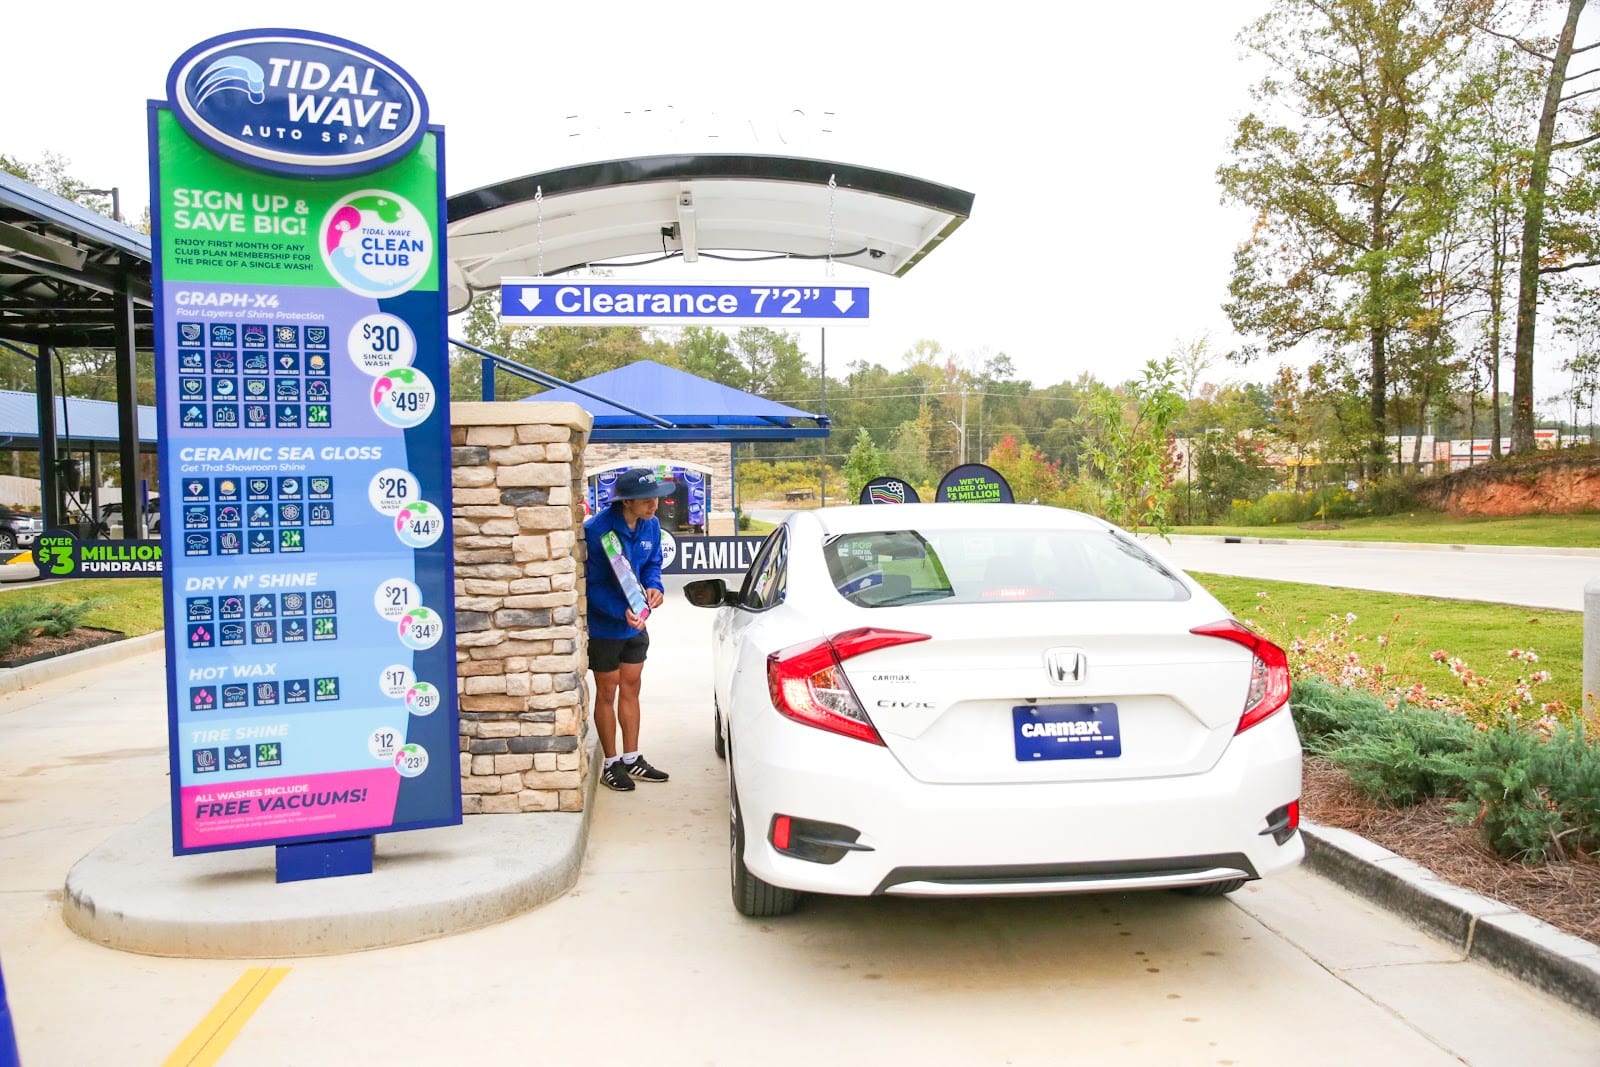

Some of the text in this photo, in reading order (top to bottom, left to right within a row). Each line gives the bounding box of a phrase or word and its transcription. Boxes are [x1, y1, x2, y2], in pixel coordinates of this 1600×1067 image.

[269, 58, 379, 96] TIDAL
[288, 93, 402, 130] WAVE
[242, 125, 365, 145] AUTO SPA
[174, 188, 310, 214] SIGN UP &
[174, 210, 307, 235] SAVE BIG!
[174, 238, 206, 246] ENJOY
[208, 240, 234, 248] FIRST
[236, 241, 268, 250] MONTH
[361, 237, 424, 252] CLEAN
[202, 249, 228, 257] PLAN
[230, 251, 290, 260] MEMBERSHIP
[362, 252, 410, 266] CLUB
[250, 261, 281, 269] SINGLE
[284, 262, 314, 270] WASH!
[175, 291, 280, 308] GRAPH-X4
[554, 287, 738, 313] Clearance
[176, 308, 324, 320] Four Layers of Shine Protection
[363, 323, 400, 352] $30
[180, 446, 382, 462] CERAMIC SEA GLOSS
[181, 463, 306, 472] Get That Showroom Shine
[379, 477, 407, 498] $26
[959, 490, 1000, 499] MILLION
[40, 538, 72, 546] OVER
[38, 546, 75, 575] $3
[681, 541, 762, 570] FAMILY
[185, 576, 230, 591] DRY
[258, 572, 318, 588] SHINE
[386, 586, 408, 605] $21
[188, 663, 277, 680] HOT WAX
[386, 671, 404, 686] $17
[877, 700, 936, 708] CIVIC
[191, 724, 289, 743] TIRE SHINE
[375, 733, 393, 748] $12
[195, 784, 309, 803] ALL WASHES INCLUDE
[195, 788, 368, 819] FREE VACUUMS!
